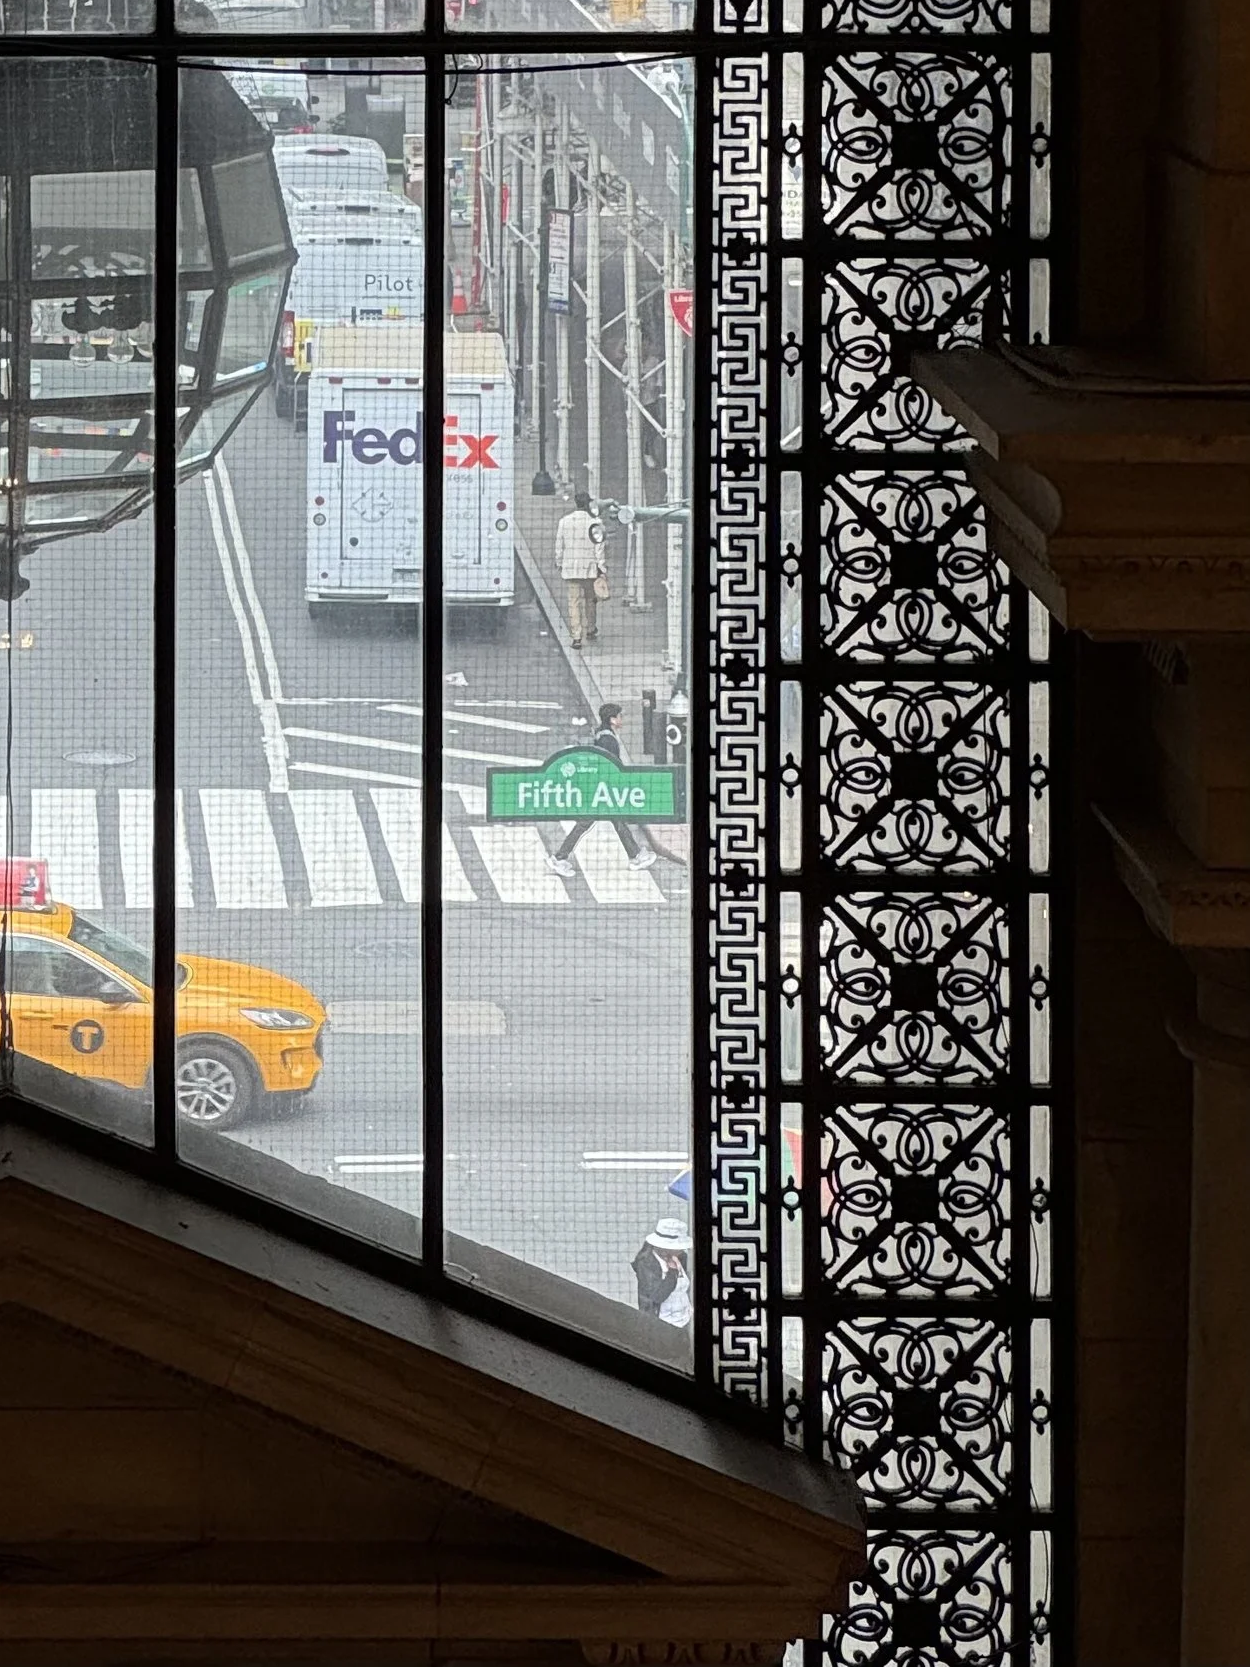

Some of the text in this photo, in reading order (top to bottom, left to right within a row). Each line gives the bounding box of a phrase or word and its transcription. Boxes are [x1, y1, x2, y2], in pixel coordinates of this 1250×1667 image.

[364, 273, 413, 292] Pilot
[518, 780, 646, 809] Fifth Ave
[77, 1026, 99, 1050] T
